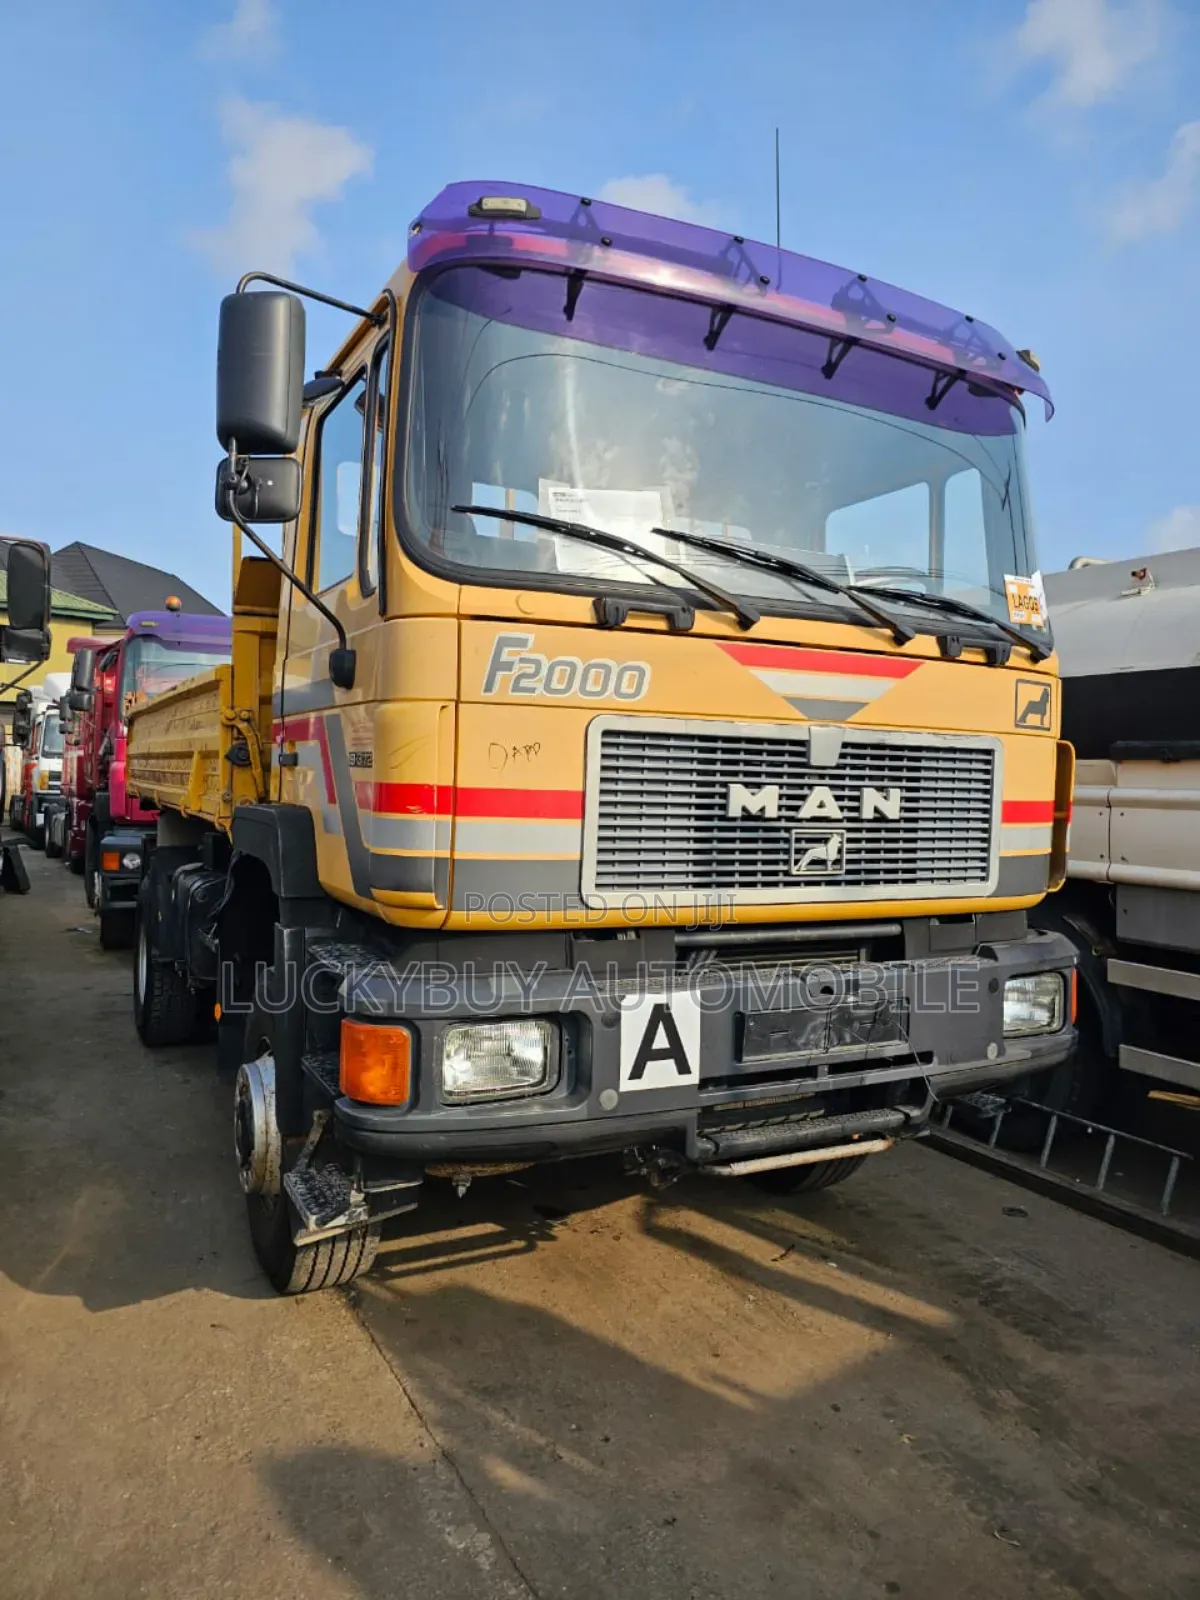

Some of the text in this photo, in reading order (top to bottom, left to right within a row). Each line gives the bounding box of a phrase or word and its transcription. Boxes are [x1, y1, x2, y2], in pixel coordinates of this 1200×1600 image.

[1012, 594, 1040, 611] LAGOS
[481, 631, 652, 702] F2000
[727, 783, 902, 820] MAN
[627, 1003, 693, 1080] A
